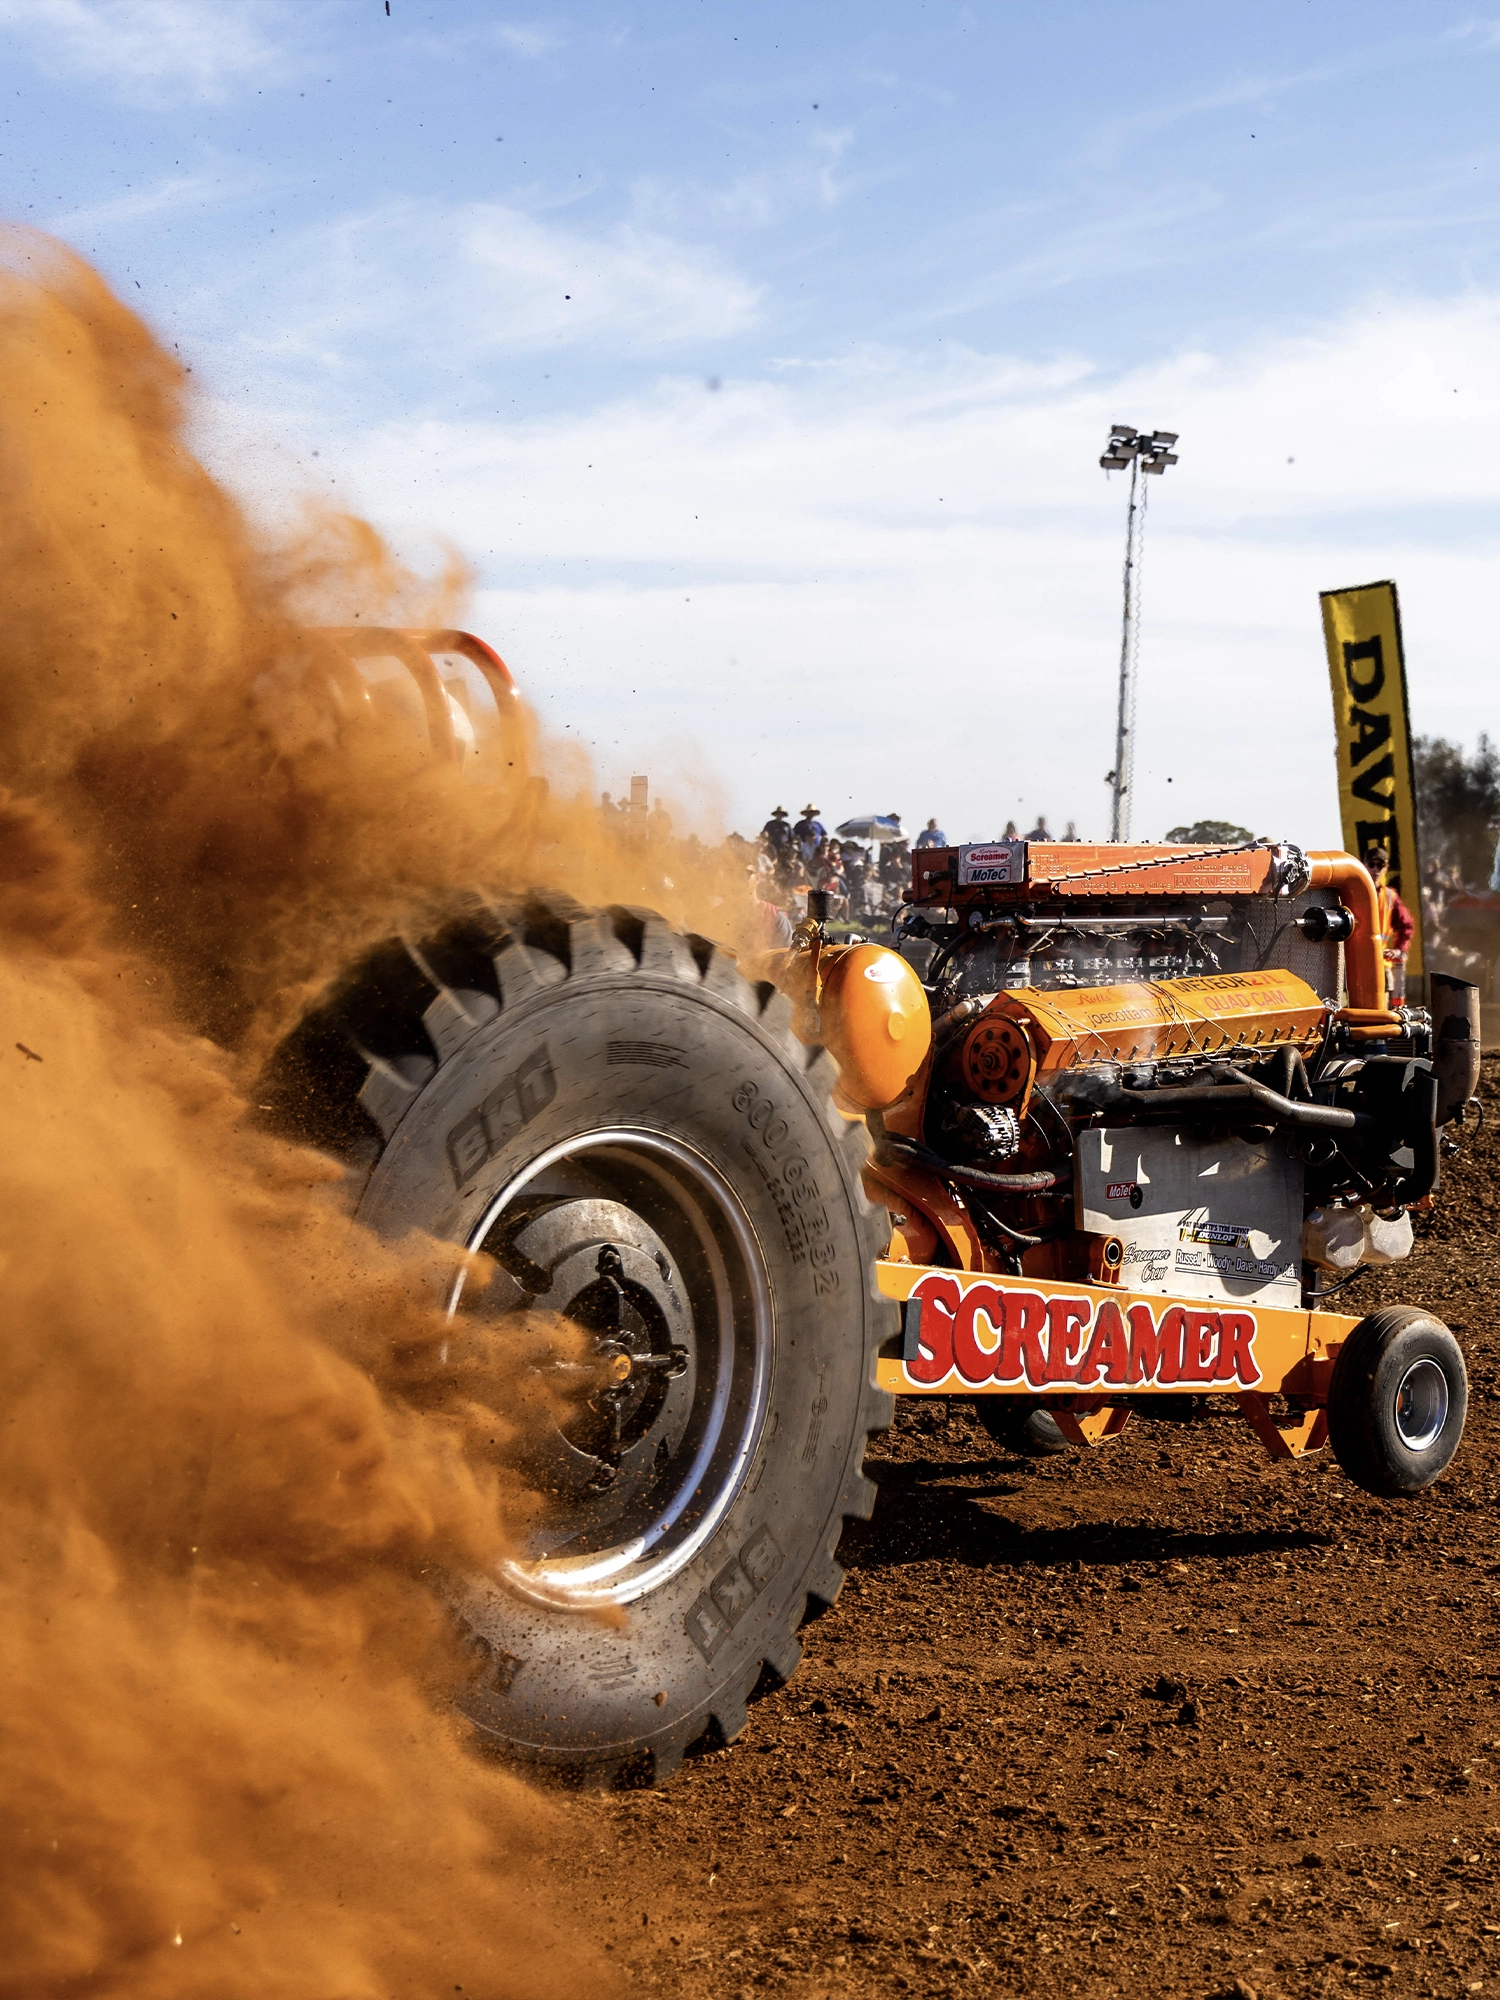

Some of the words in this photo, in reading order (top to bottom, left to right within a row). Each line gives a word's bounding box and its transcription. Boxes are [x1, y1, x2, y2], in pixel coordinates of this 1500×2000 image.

[1343, 634, 1401, 892] DAVE
[970, 853, 1009, 862] Screamer
[970, 868, 1007, 881] MoTeC
[1174, 876, 1192, 888] IAN
[1169, 975, 1252, 993] METEOR
[1203, 993, 1251, 1011] QUAD
[1250, 989, 1289, 1007] CAM
[1198, 1231, 1235, 1242] DUNLOP
[1121, 1241, 1171, 1265] Screamer
[1175, 1249, 1202, 1266] Russell
[1207, 1253, 1232, 1272] Woody
[1235, 1257, 1253, 1273] Dave
[1258, 1260, 1279, 1277] Hardy
[1141, 1260, 1168, 1283] Crew
[904, 1274, 1263, 1388] SCREAMER
